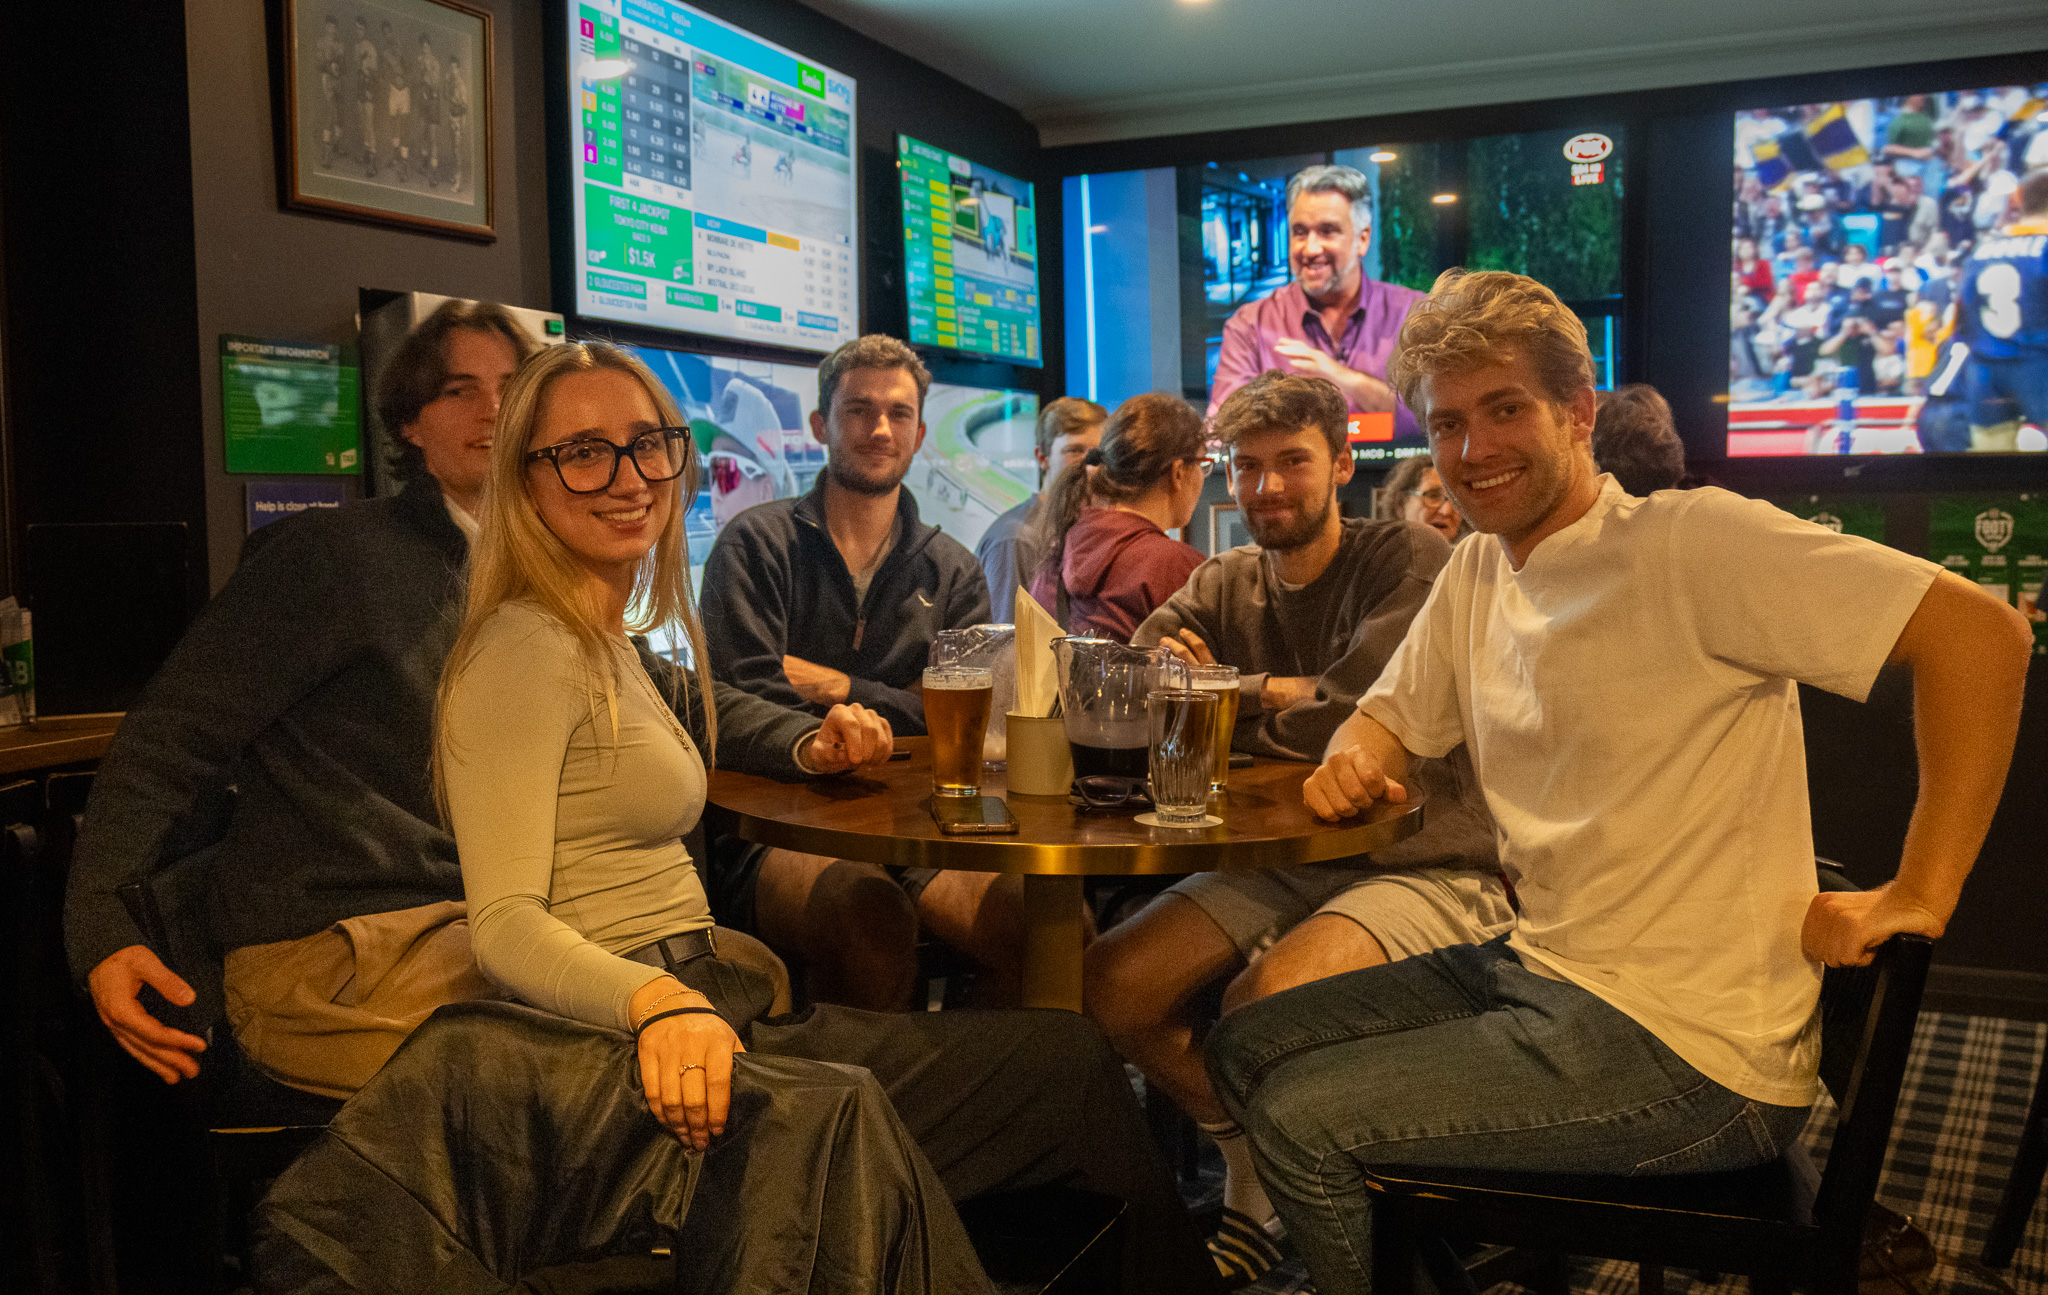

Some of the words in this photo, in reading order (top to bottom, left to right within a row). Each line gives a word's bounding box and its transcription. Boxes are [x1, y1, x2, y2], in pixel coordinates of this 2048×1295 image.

[587, 130, 593, 142] 7
[587, 148, 594, 162] 8
[609, 194, 631, 210] FIRST
[632, 201, 638, 212] 4
[638, 202, 670, 220] JACKPOT
[614, 213, 635, 229] TOKYO
[635, 218, 649, 231] CITY
[628, 247, 656, 268] $1.5K
[594, 277, 629, 292] GLOUCESTER
[629, 284, 644, 295] PARK
[1976, 262, 2022, 338] 3
[227, 341, 274, 354] IMPORTANT
[275, 346, 329, 360] INFORMATION
[255, 501, 276, 512] Help
[277, 500, 285, 511] is
[286, 501, 308, 511] close
